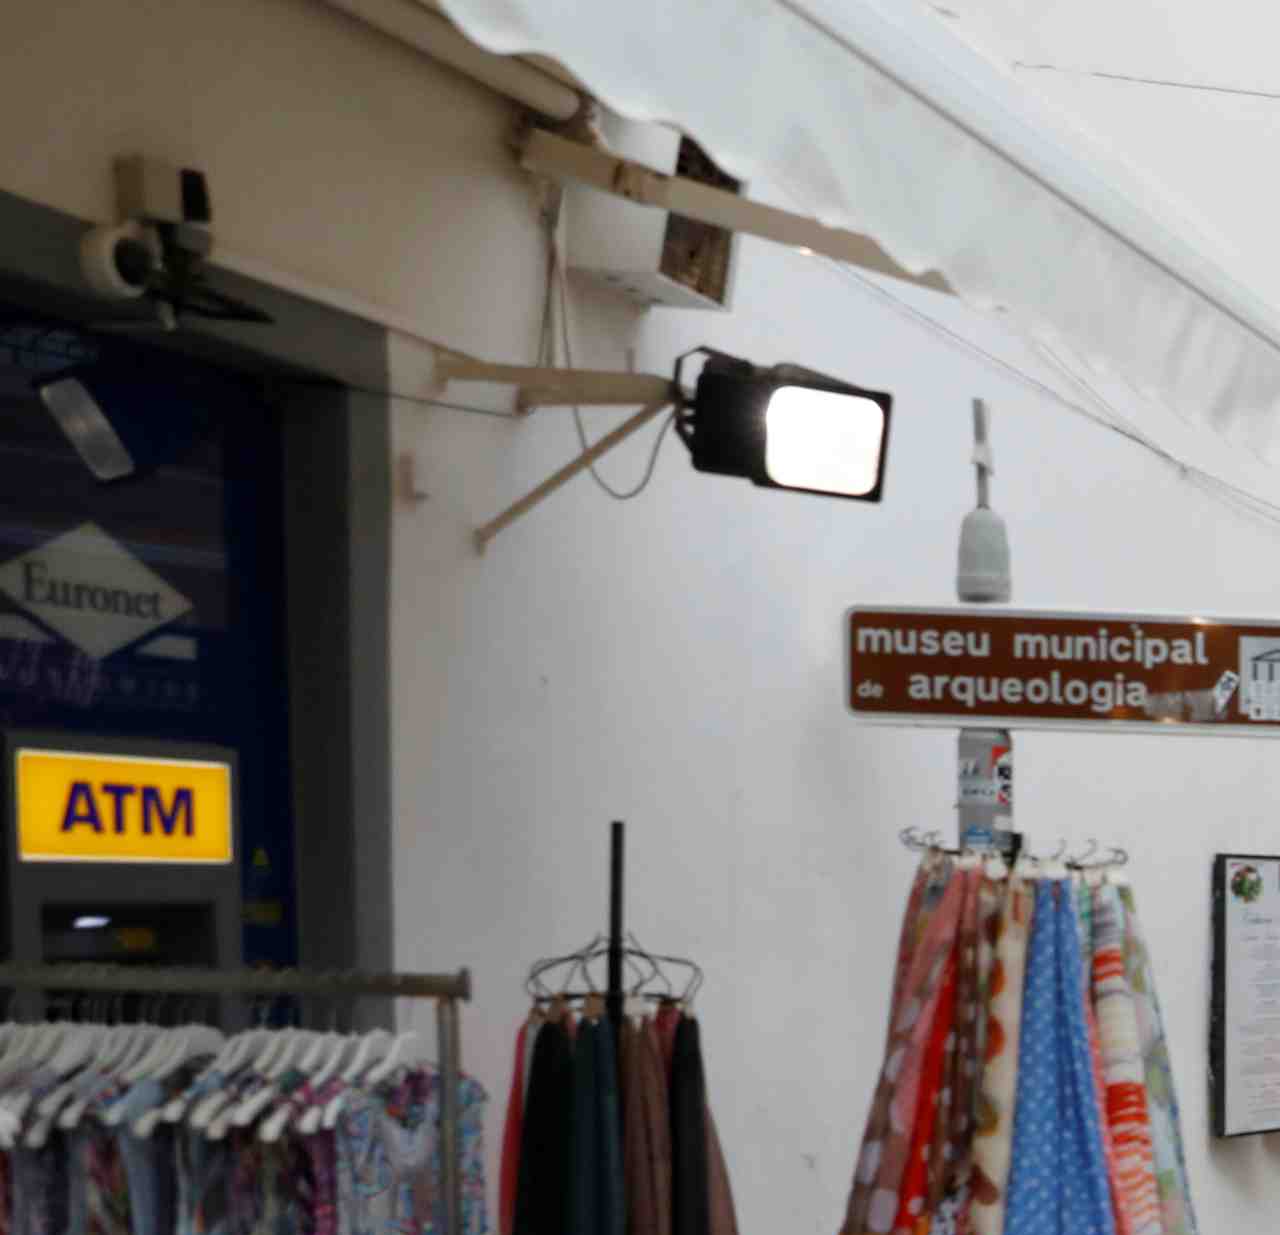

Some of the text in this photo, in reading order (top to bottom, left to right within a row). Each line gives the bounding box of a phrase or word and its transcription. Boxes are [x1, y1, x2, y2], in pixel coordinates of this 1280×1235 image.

[21, 559, 163, 622] Euronet
[856, 624, 1209, 668] museu municipal
[857, 671, 1149, 711] de arqueologia
[60, 780, 196, 838] ATM
